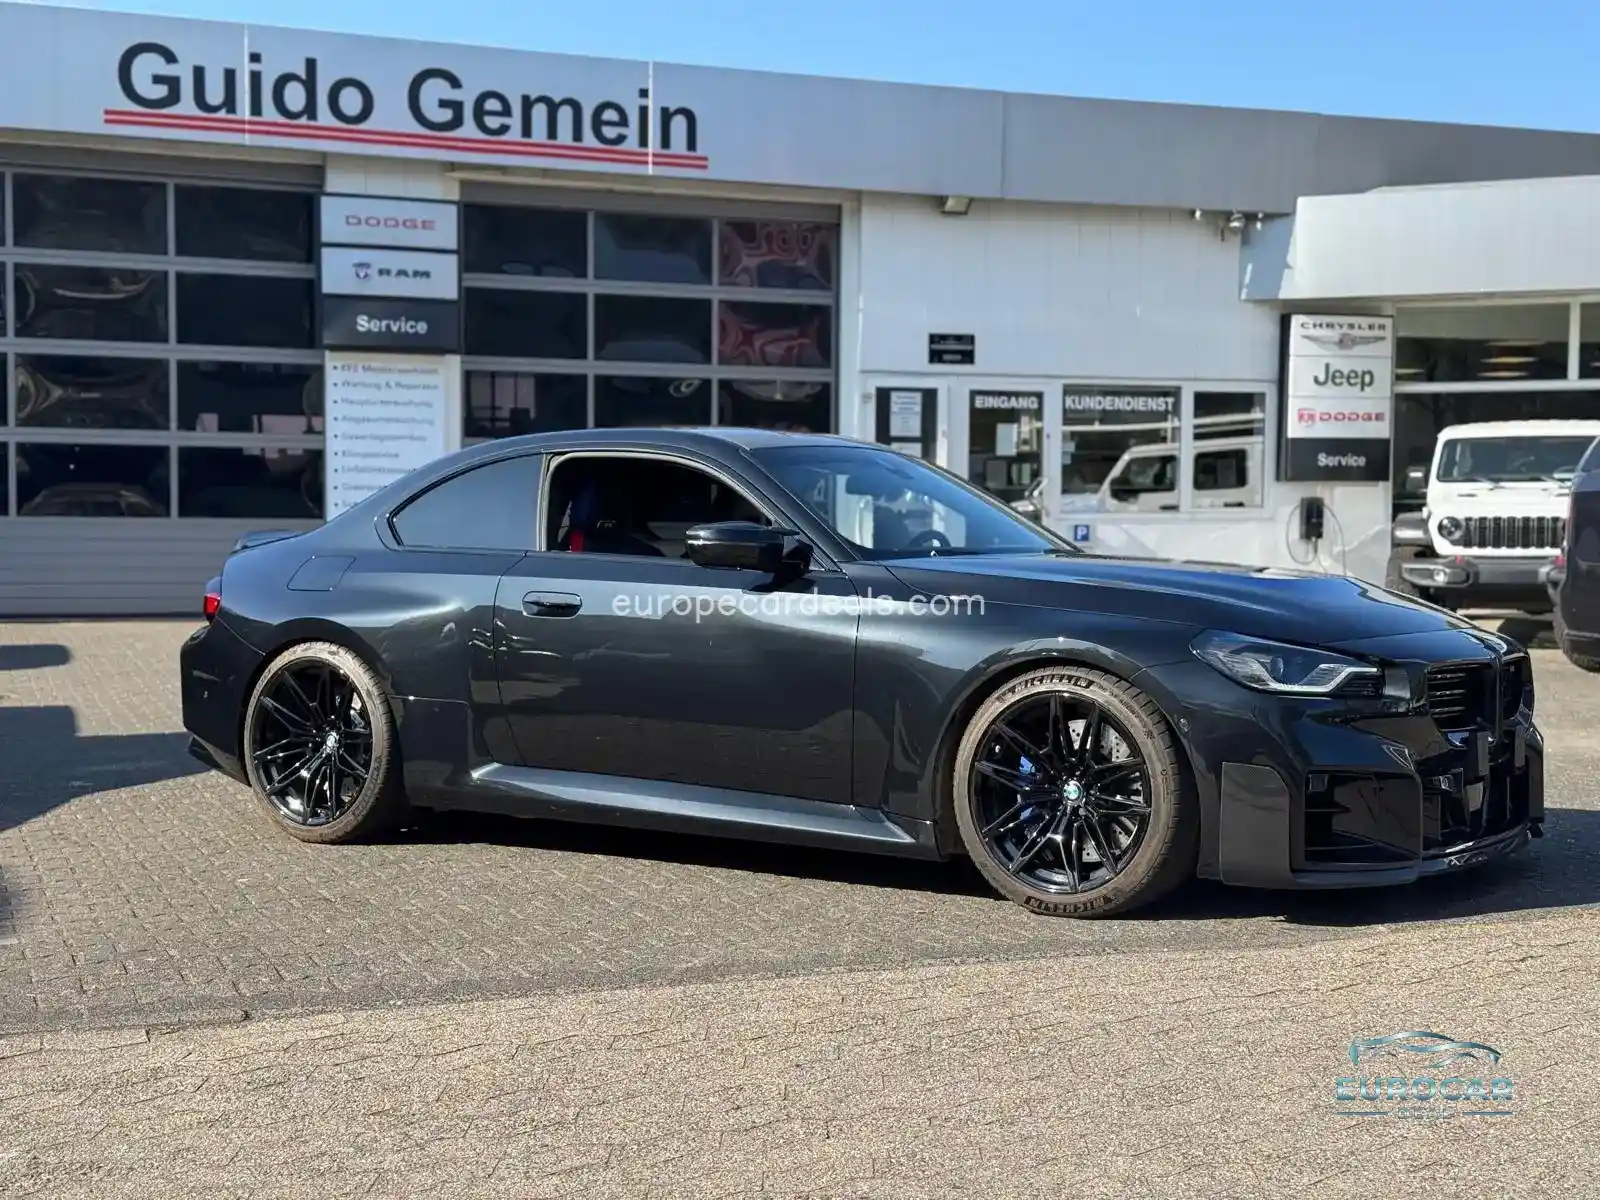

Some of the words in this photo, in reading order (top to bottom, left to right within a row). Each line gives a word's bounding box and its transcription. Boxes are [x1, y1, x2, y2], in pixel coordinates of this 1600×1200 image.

[117, 42, 375, 125] Guido
[407, 67, 699, 153] Gemein
[345, 214, 436, 231] DODGE
[377, 267, 431, 280] RAM
[356, 313, 429, 335] Service
[1300, 322, 1386, 332] CHRYSLER
[1313, 362, 1375, 392] Jeep
[974, 395, 1039, 410] EINGANG
[1065, 395, 1175, 412] KUNDENDIENST
[1319, 411, 1386, 422] DODGE
[1317, 453, 1367, 467] Service
[1077, 526, 1088, 540] P
[1015, 674, 1091, 693] MICHELIN
